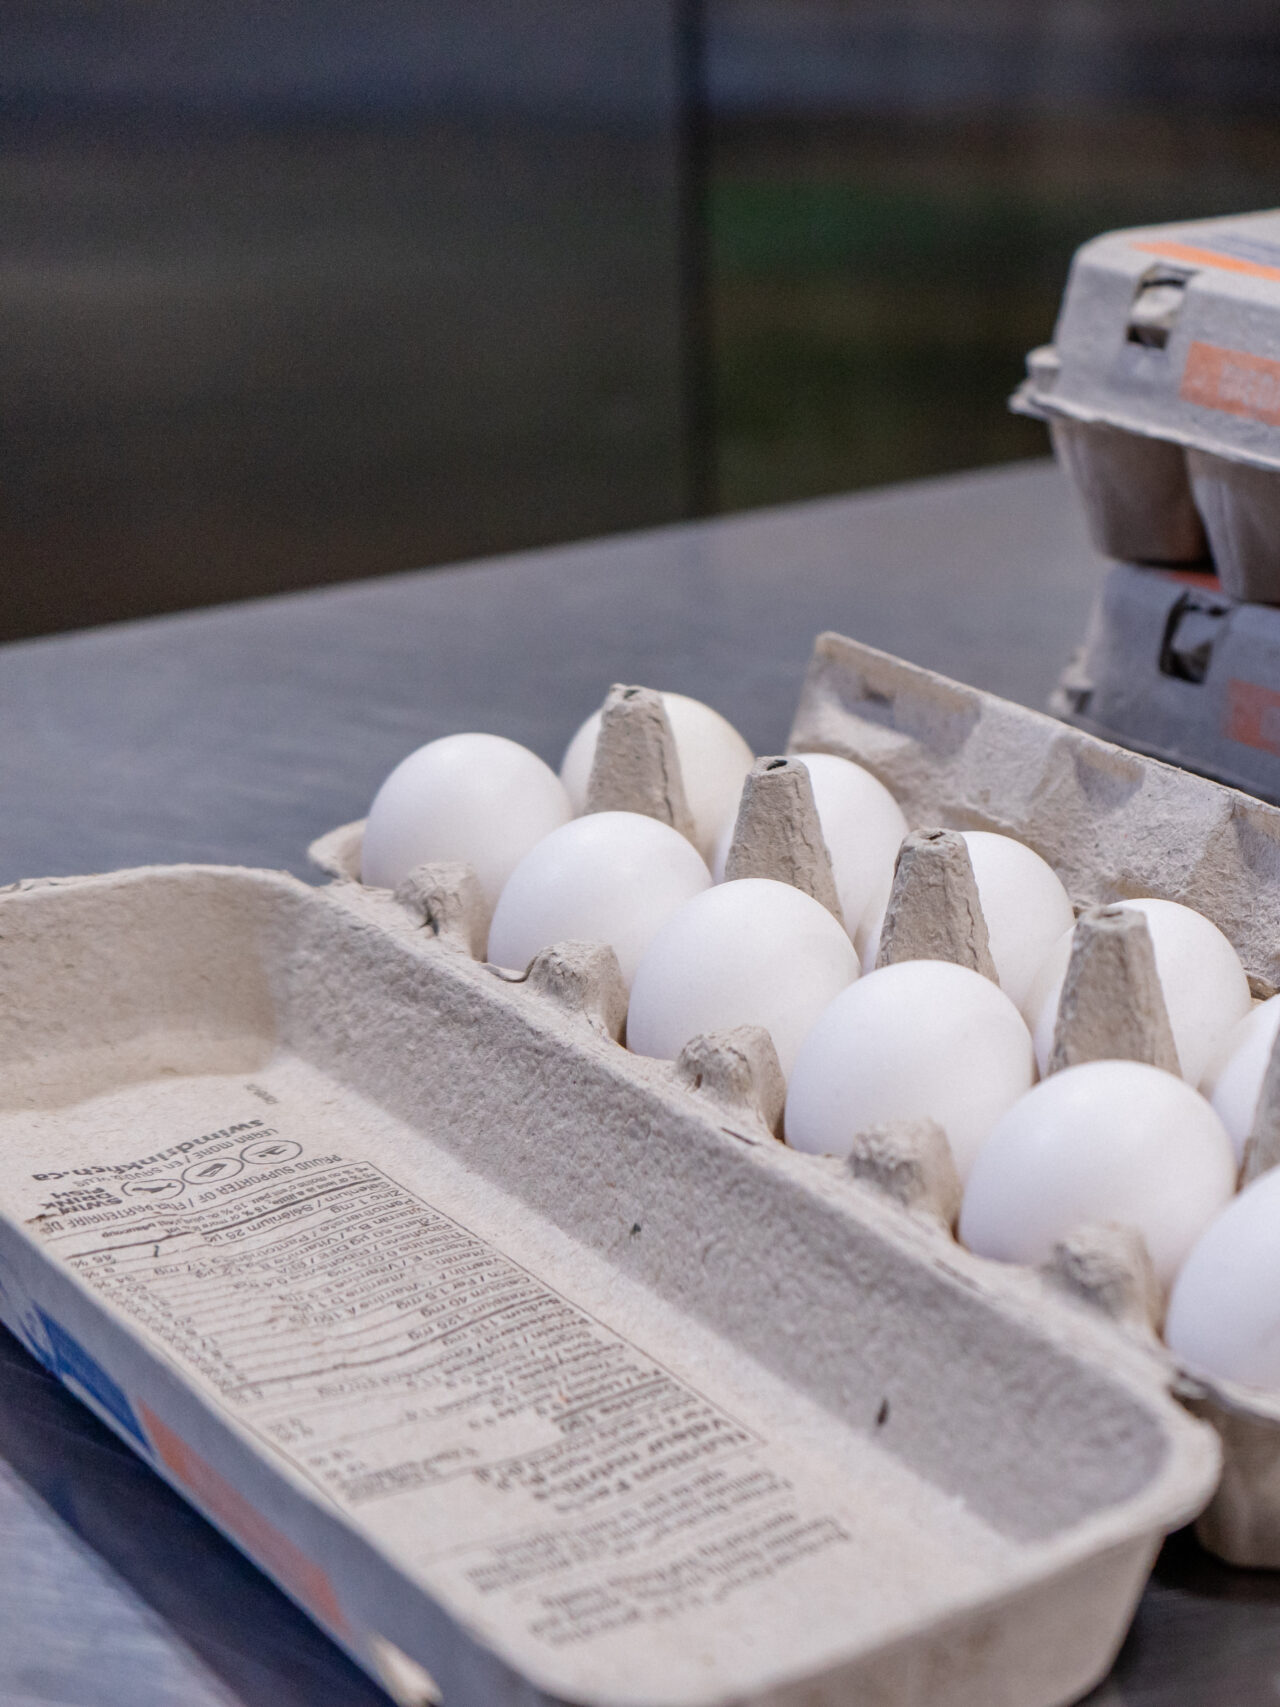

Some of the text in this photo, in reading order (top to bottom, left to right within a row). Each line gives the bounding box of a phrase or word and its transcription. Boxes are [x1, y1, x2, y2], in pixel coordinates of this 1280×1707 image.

[232, 1127, 279, 1145] LEARN
[190, 1140, 234, 1159] MORE
[293, 1153, 343, 1171] PROUD
[214, 1165, 296, 1195] SUPPORTER
[323, 1180, 391, 1203] Selenium
[368, 1188, 403, 1201] Zinc
[328, 1201, 356, 1214] mg
